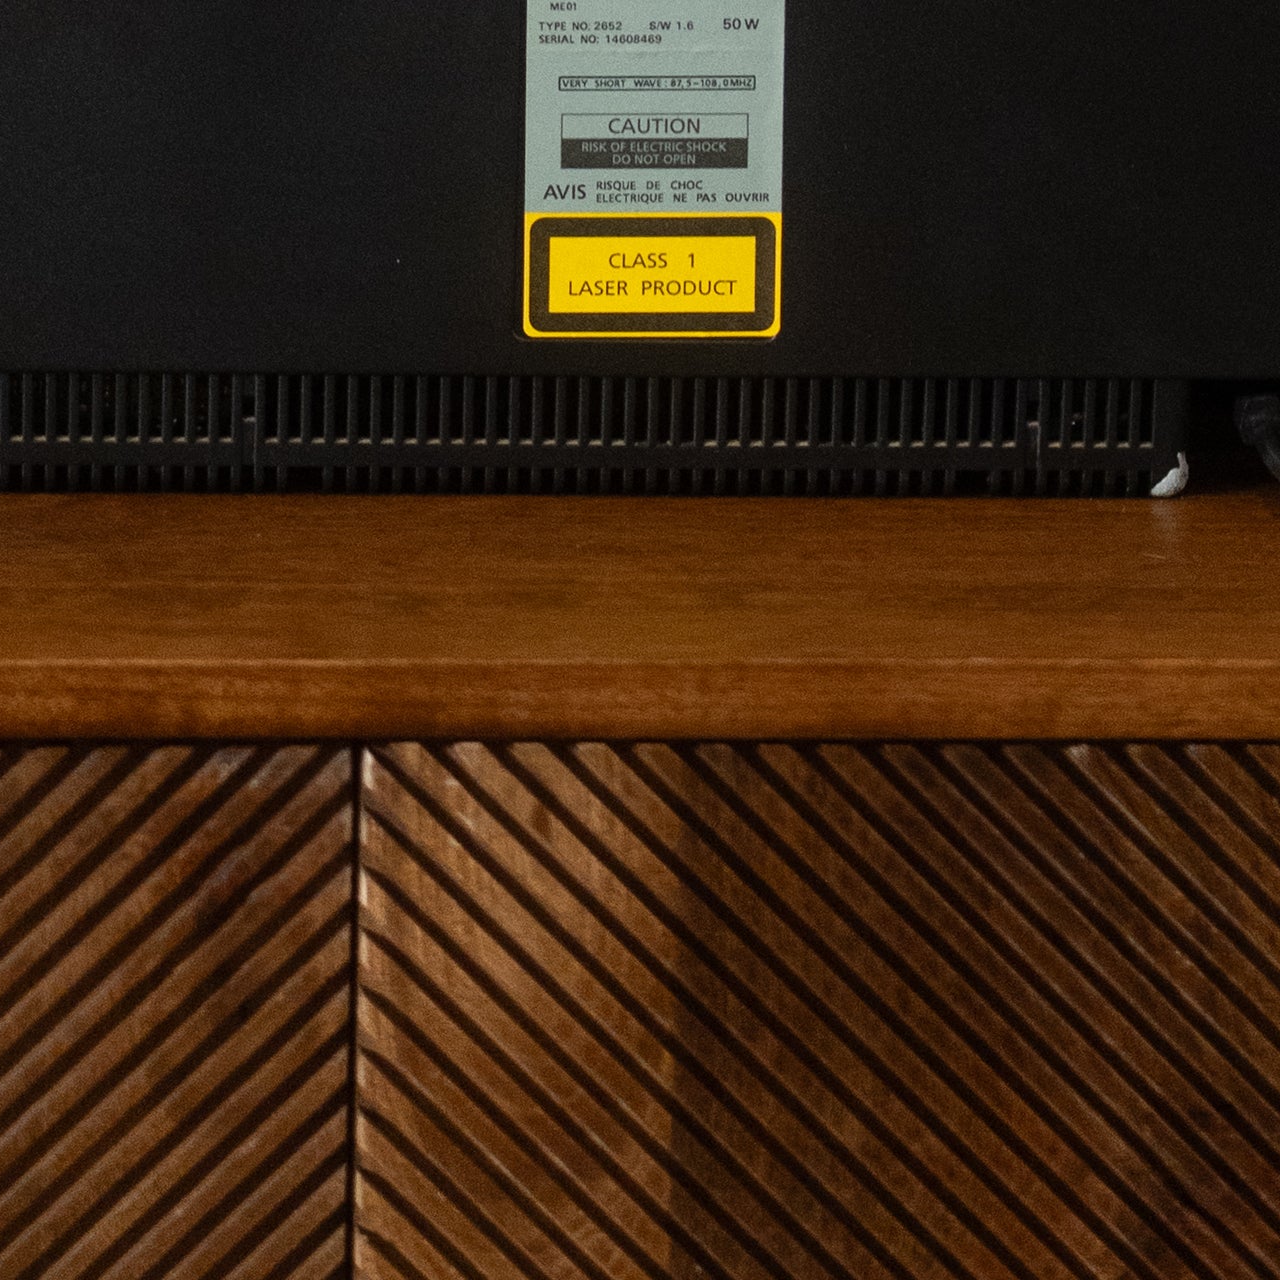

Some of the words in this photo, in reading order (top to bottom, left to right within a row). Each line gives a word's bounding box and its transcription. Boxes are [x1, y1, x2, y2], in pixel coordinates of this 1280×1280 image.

[539, 21, 566, 32] TYPE
[593, 20, 623, 31] 2652
[648, 20, 672, 31] S/W
[676, 20, 694, 31] 1.6
[538, 34, 575, 45] SERIAL
[562, 78, 587, 87] VERY
[594, 78, 625, 87] SHORT
[607, 117, 701, 134] CAUTION
[581, 142, 607, 152] RISK
[610, 142, 626, 151] OF
[630, 142, 683, 151] ELECTRIC
[686, 142, 726, 151] SHOCK
[613, 155, 630, 165] DO
[634, 154, 660, 164] NOT
[664, 154, 696, 164] OPEN
[596, 180, 636, 192] RISQUE
[645, 180, 660, 191] DE
[670, 179, 703, 191] CHOC
[542, 183, 587, 201] AVIS
[595, 192, 664, 205] ELECTRIQUE
[672, 192, 687, 203] NE
[696, 192, 717, 203] PAS
[724, 192, 770, 203] OUVRIR
[608, 252, 668, 270] CLASS
[688, 252, 695, 269] 1
[568, 279, 629, 297] LASER
[641, 279, 738, 297] PRODUCT
